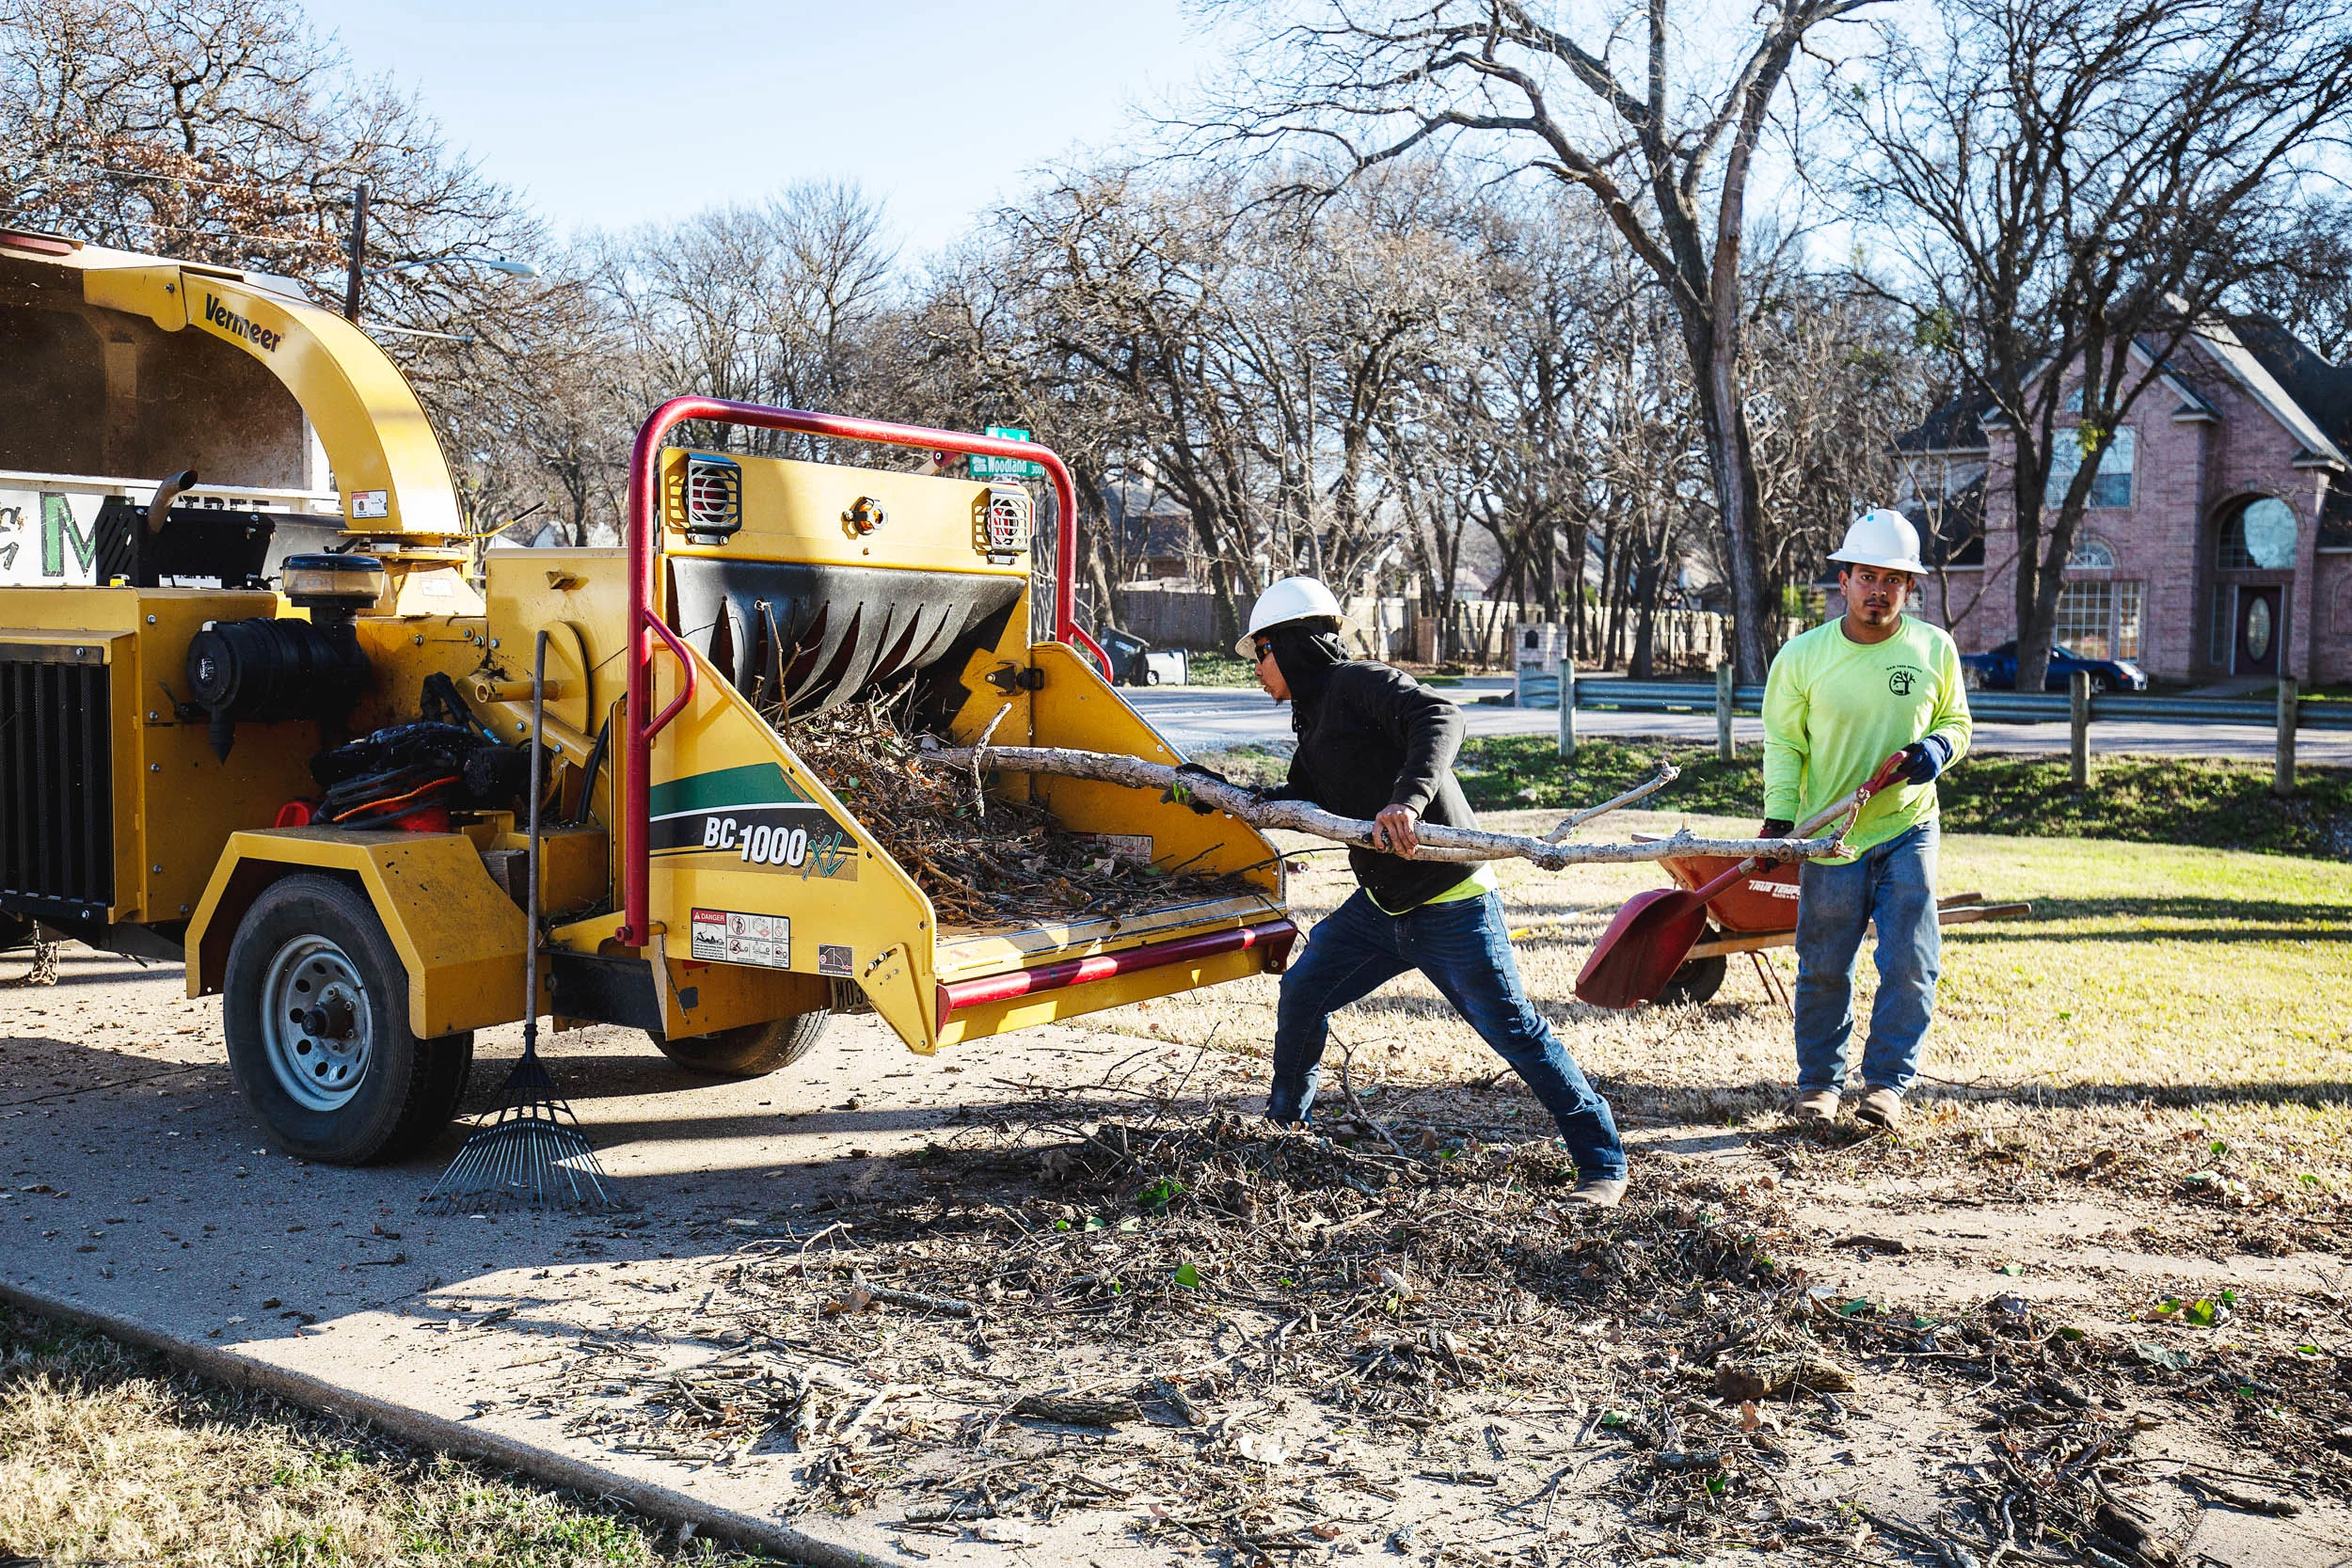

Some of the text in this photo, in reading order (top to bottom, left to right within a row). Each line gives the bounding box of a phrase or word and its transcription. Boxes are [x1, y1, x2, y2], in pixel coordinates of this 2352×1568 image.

[205, 293, 280, 353] Vermeer
[988, 456, 1027, 472] Woodland
[701, 913, 724, 922] DANGER
